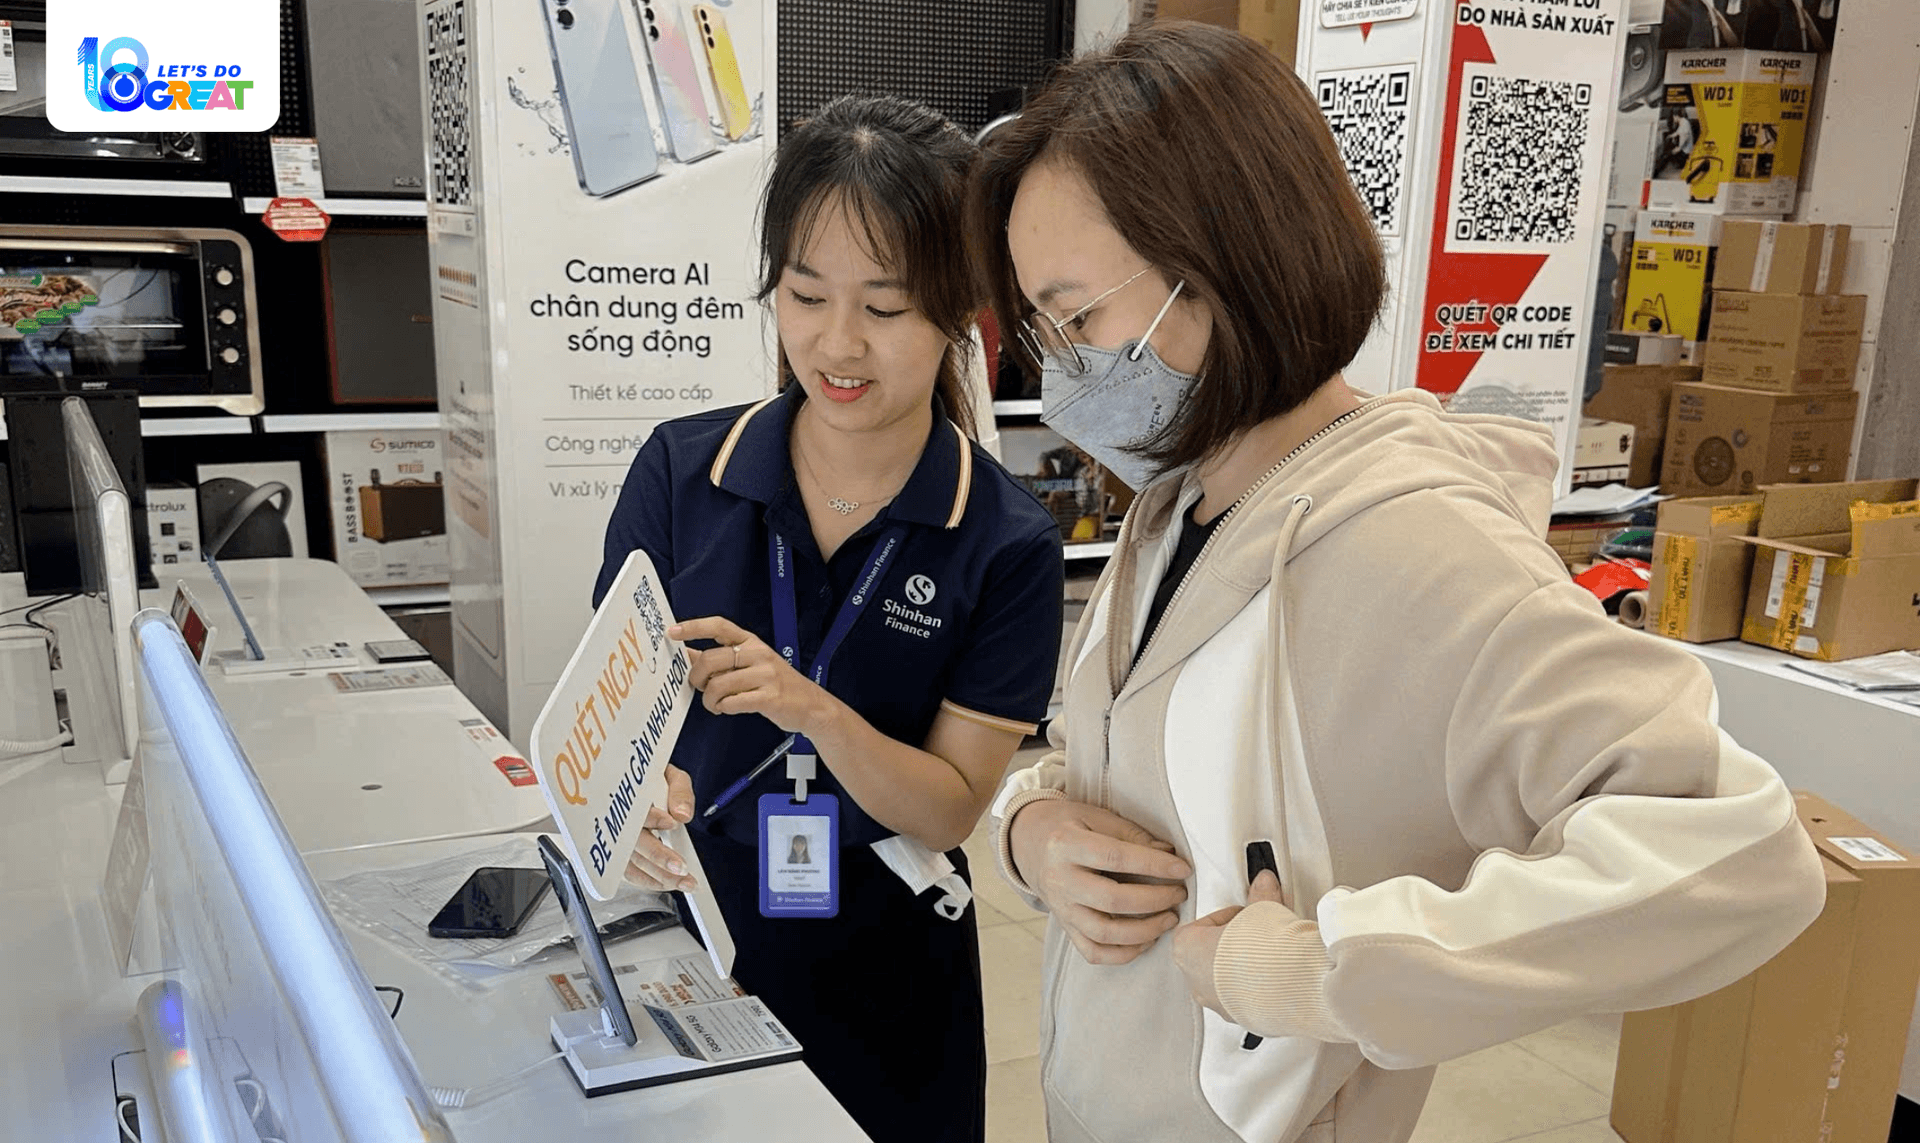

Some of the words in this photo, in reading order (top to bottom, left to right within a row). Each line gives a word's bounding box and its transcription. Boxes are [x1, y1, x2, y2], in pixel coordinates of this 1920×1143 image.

[1460, 6, 1485, 24] DO
[1490, 7, 1527, 28] NHÀ
[1531, 8, 1566, 31] SẢN
[1570, 13, 1615, 36] XUẤT
[565, 259, 676, 285] Camera
[684, 262, 710, 286] AI
[530, 294, 599, 318] chân
[608, 295, 678, 324] dung
[686, 296, 744, 320] đêm
[1437, 301, 1487, 325] QUÉT
[1491, 306, 1518, 326] QR
[1523, 306, 1572, 322] CODE
[567, 326, 633, 358] sống
[642, 330, 711, 359] động
[1427, 327, 1454, 351] ĐỂ
[1457, 334, 1497, 350] XEM
[1502, 334, 1533, 350] CHI
[1538, 327, 1576, 350] TIẾT
[569, 384, 612, 400] Thiết
[617, 384, 637, 401] kế
[641, 387, 675, 401] cao
[679, 384, 713, 403] cấp
[545, 435, 594, 454] Công
[549, 481, 565, 497] Vi
[569, 481, 591, 497] xử
[595, 481, 608, 499] lý
[777, 545, 785, 578] Finance
[857, 565, 880, 596] Shinhan
[874, 537, 897, 568] Finance
[881, 598, 942, 629] Shinhan
[884, 615, 931, 639] Finance
[555, 693, 607, 806] QUÉT
[597, 618, 646, 723] NGAY
[589, 817, 613, 878] ĐỂ
[604, 772, 638, 844] MÌNH
[629, 731, 654, 788] GẦN
[646, 687, 675, 740] NHAU
